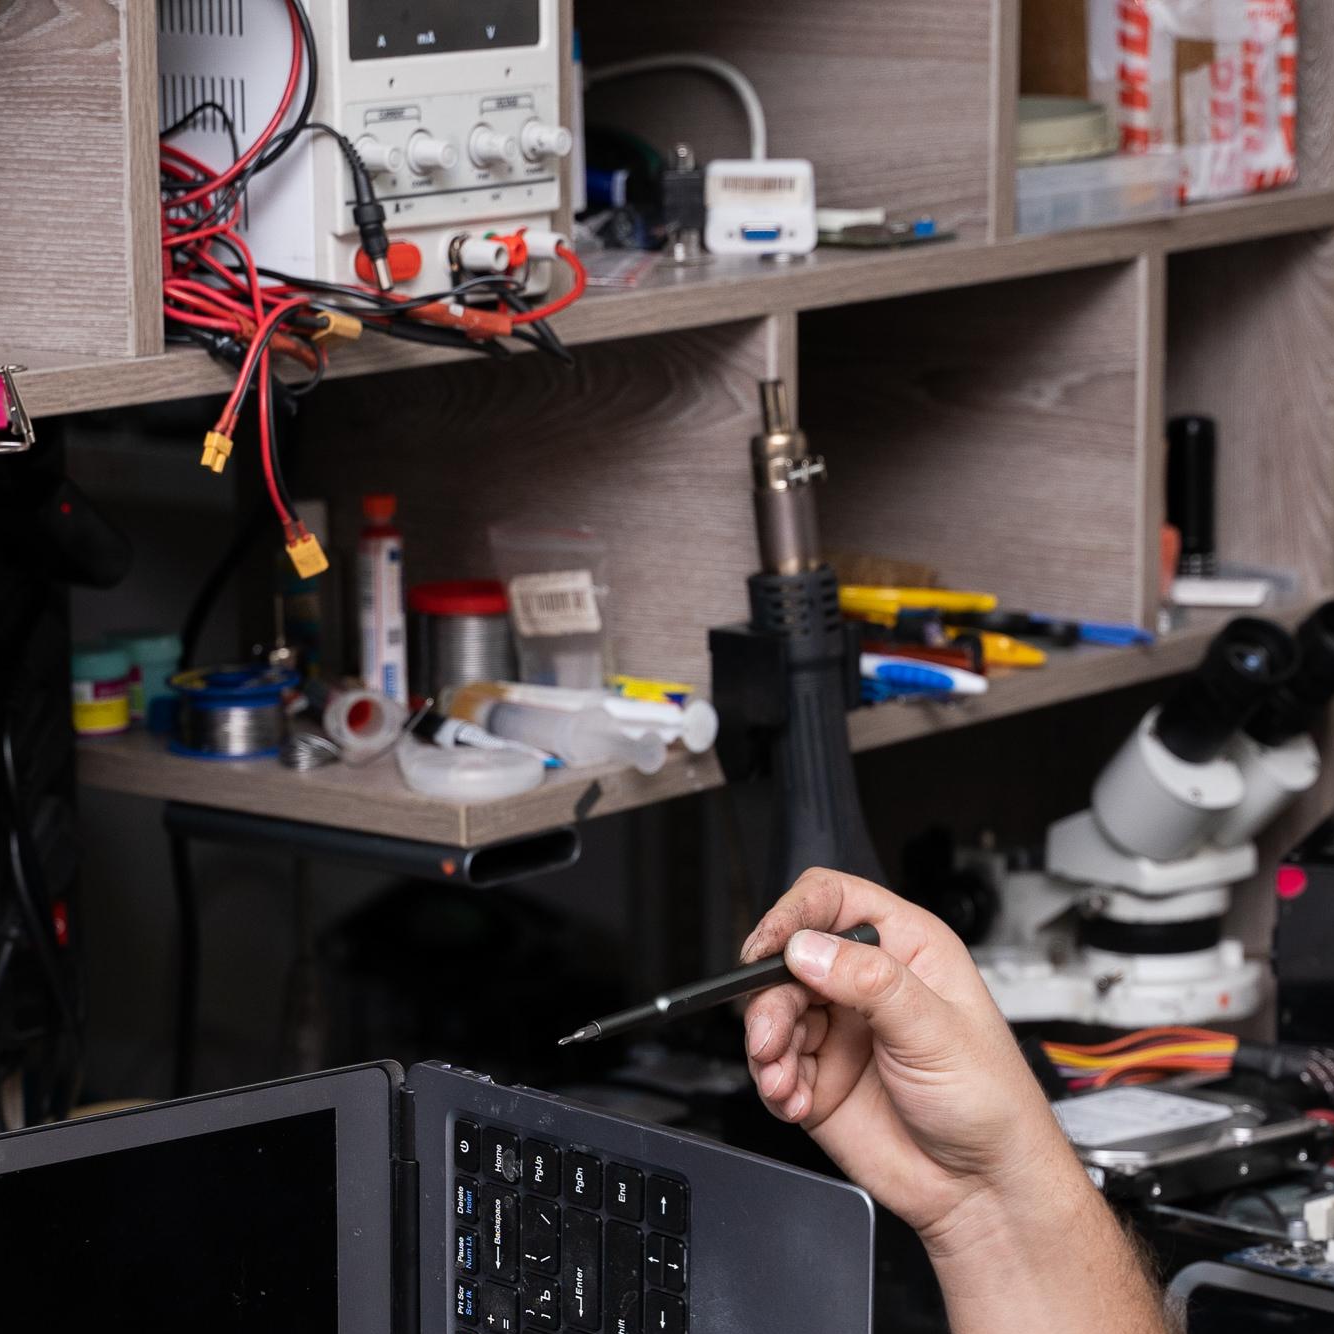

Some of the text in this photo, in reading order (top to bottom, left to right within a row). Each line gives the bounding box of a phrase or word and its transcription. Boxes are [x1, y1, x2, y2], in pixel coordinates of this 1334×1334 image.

[377, 34, 387, 48] A
[417, 30, 435, 44] mA
[485, 25, 495, 40] V
[535, 1156, 543, 1182] PgUp
[575, 1167, 583, 1194] PgDn
[618, 1182, 626, 1202] End
[575, 1267, 583, 1295] Enter
